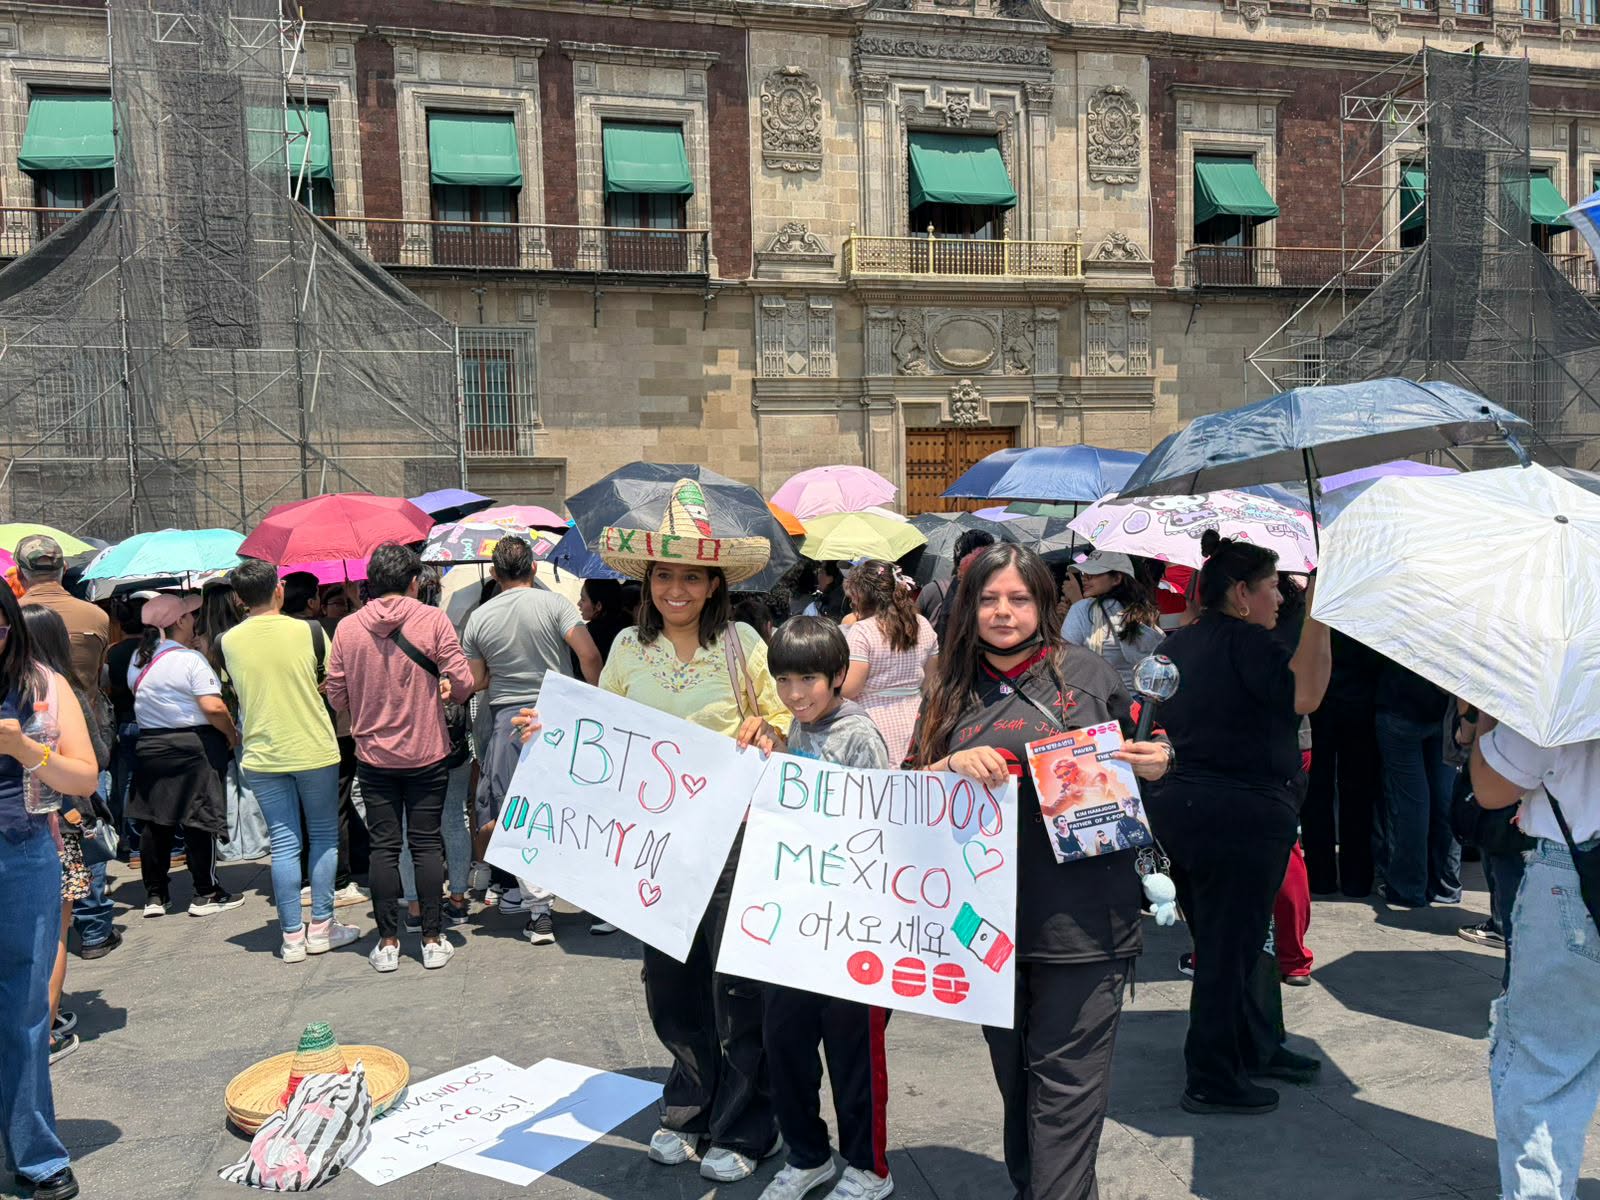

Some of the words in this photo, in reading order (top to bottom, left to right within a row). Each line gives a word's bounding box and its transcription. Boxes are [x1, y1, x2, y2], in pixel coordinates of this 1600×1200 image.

[569, 718, 681, 814] BTS
[778, 761, 1003, 837] BIENVENIDOS
[527, 801, 637, 867] ARMY
[1069, 820, 1093, 830] FATHER
[1106, 812, 1125, 821] K-POP
[774, 841, 951, 909] MÉXICO
[440, 1103, 454, 1112] A
